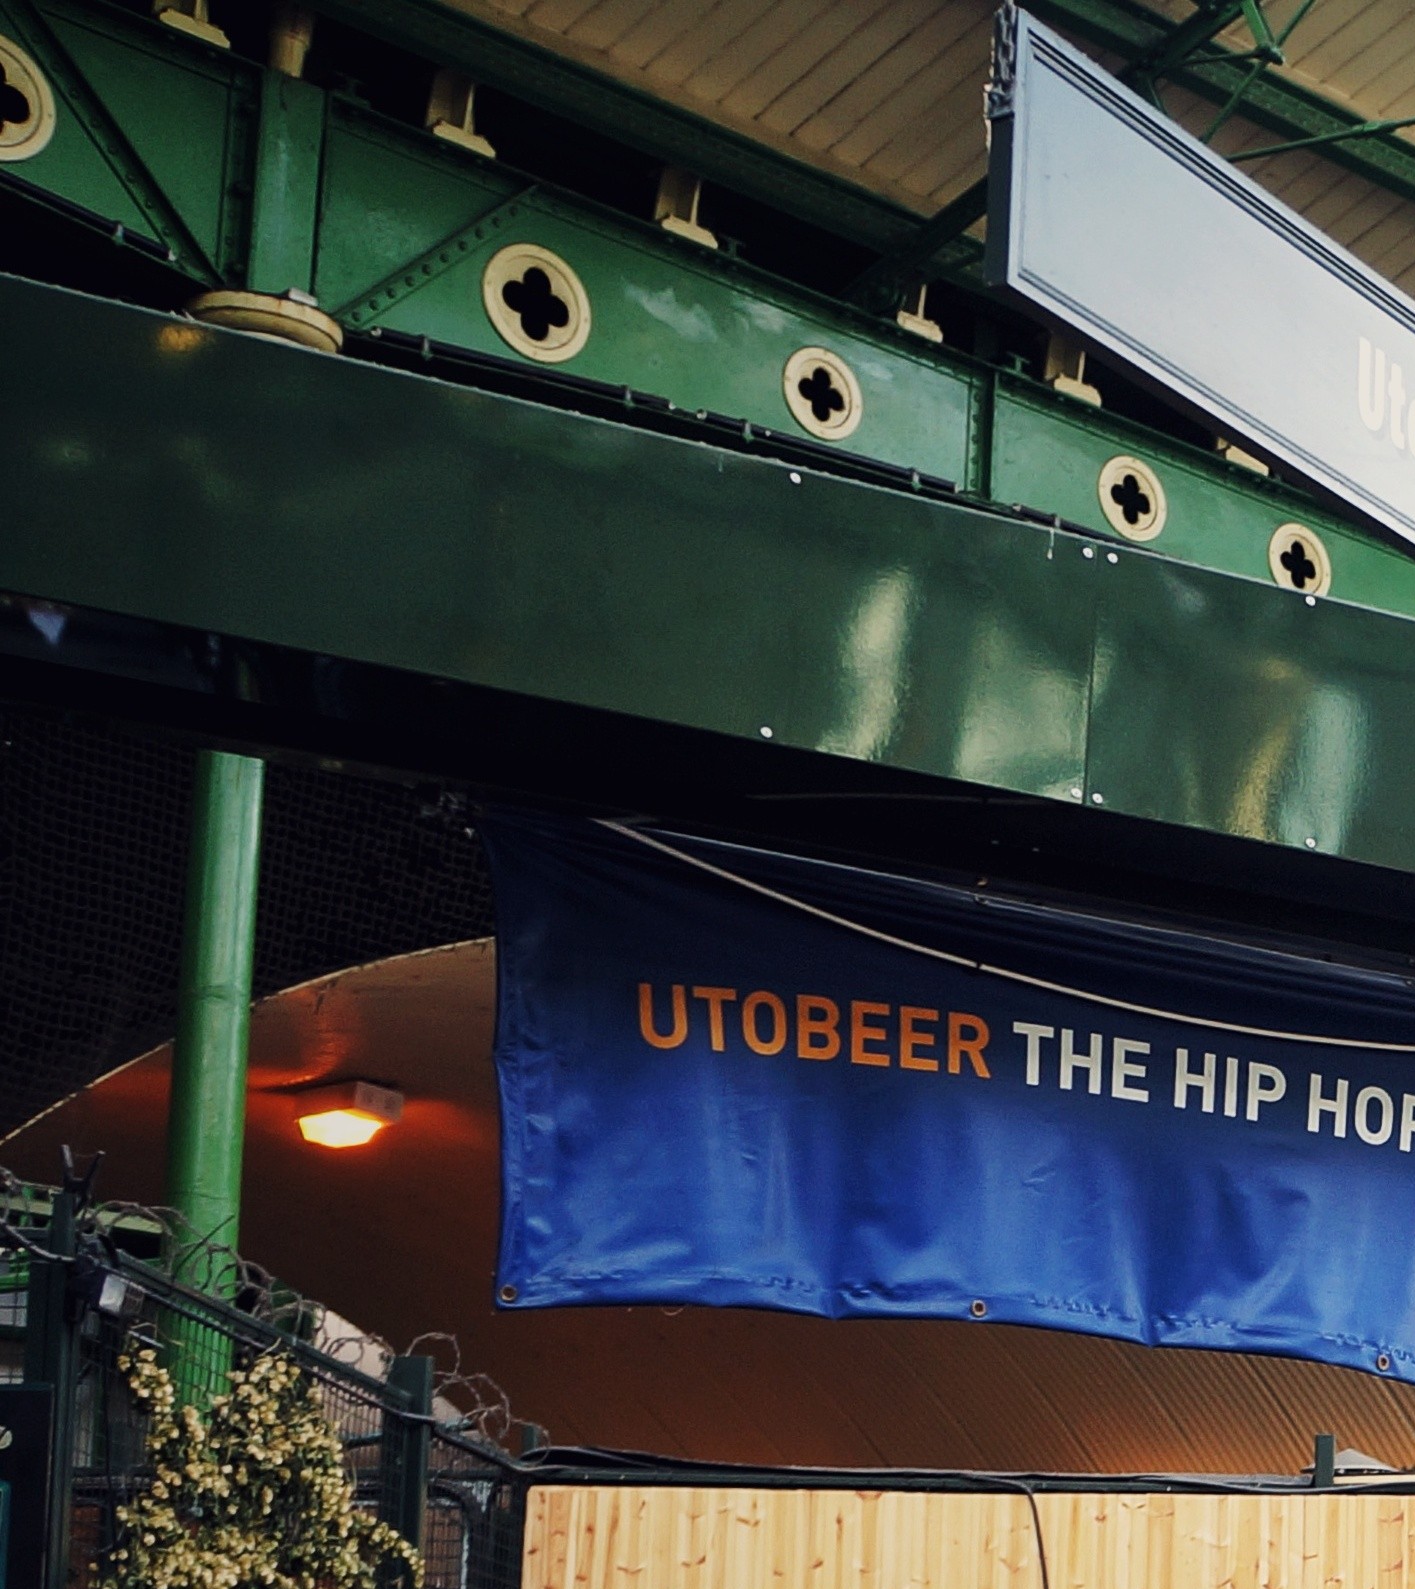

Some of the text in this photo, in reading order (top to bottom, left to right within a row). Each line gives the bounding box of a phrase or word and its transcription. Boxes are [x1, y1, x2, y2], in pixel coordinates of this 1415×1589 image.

[637, 983, 993, 1080] UTOBEER
[1013, 1020, 1148, 1102] THE
[1174, 1045, 1287, 1123] HIP
